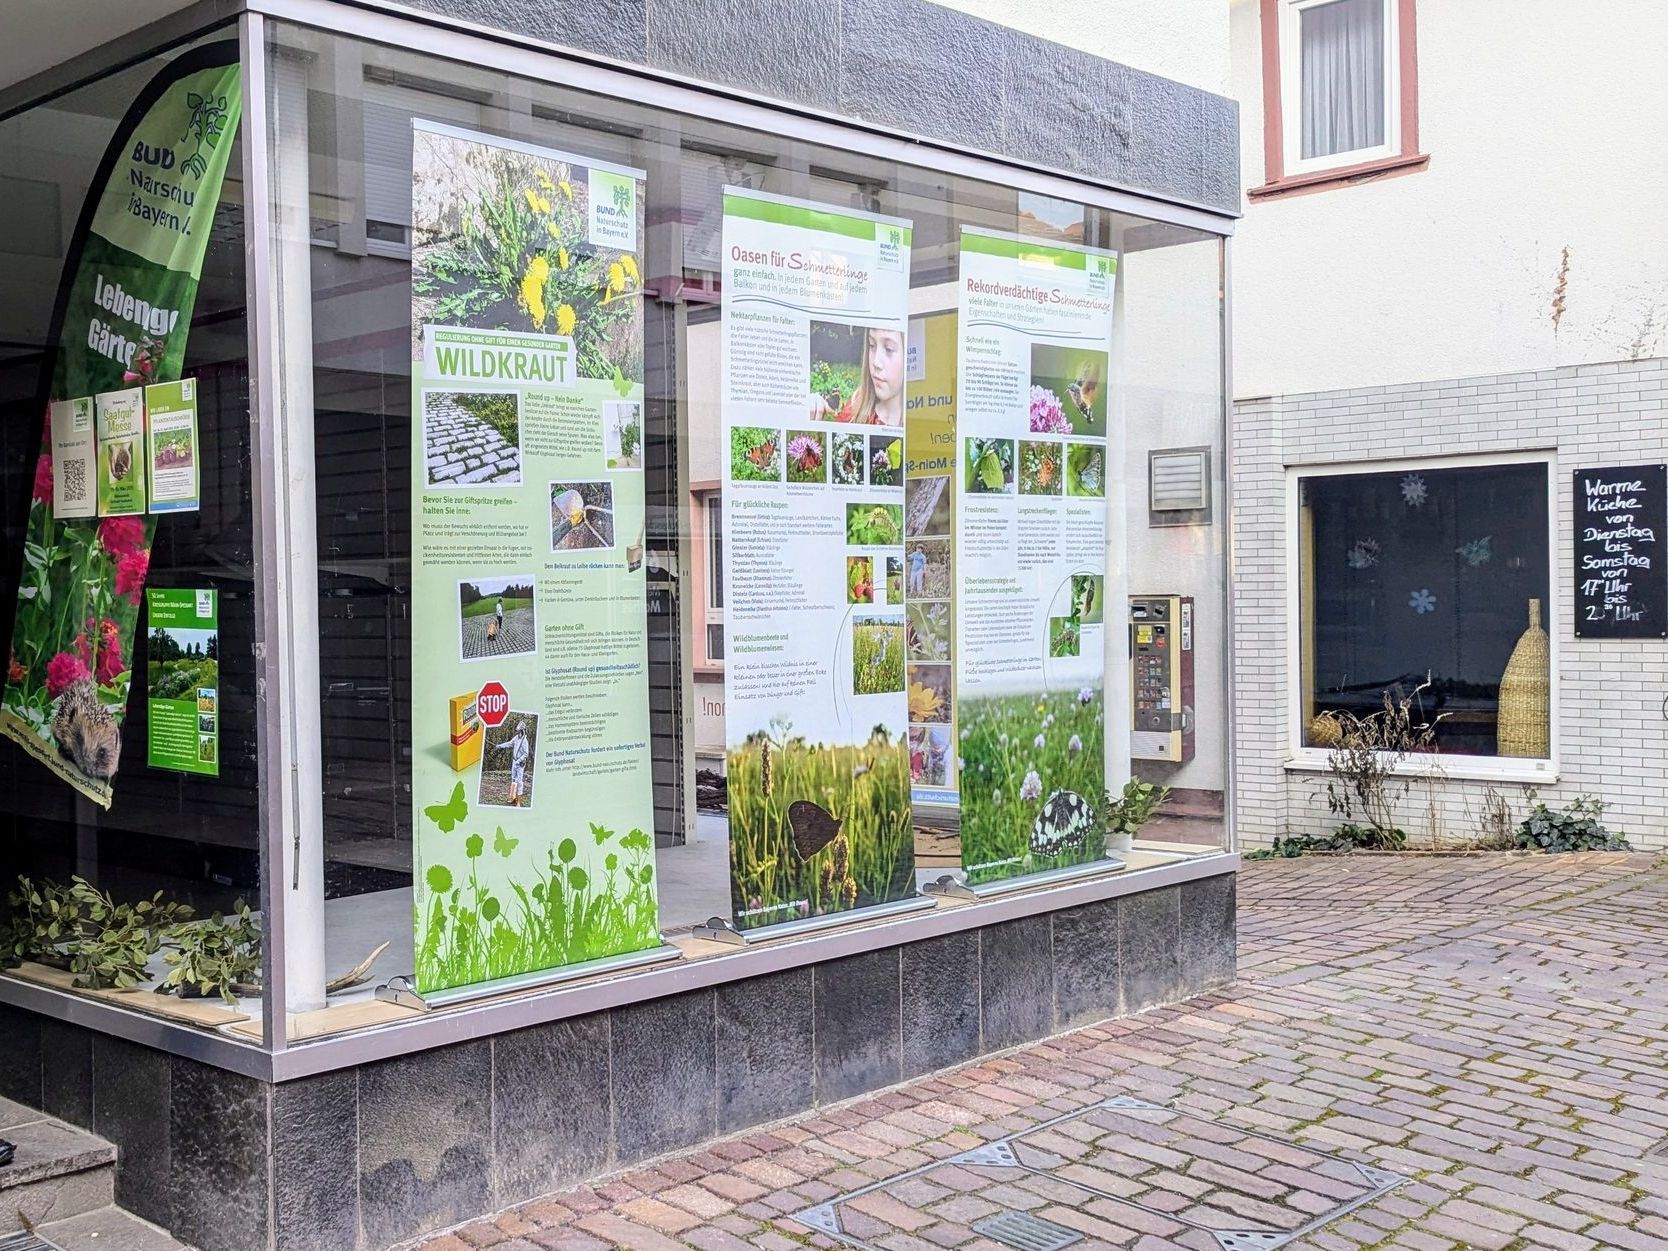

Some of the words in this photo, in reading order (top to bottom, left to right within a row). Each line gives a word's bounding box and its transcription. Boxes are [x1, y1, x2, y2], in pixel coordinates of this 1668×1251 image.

[597, 205, 615, 215] BUND
[596, 216, 628, 229] Naturschutz
[602, 227, 620, 237] Bayern
[732, 246, 768, 265] Oasen
[770, 250, 785, 268] für
[788, 253, 868, 282] Schmetterlinge
[734, 268, 751, 279] ganz
[784, 274, 804, 286] jedem
[734, 279, 757, 290] Balkon
[759, 281, 771, 292] und
[772, 283, 778, 292] in
[778, 284, 799, 296] jedem
[968, 278, 1048, 304] Rekordverdächtige
[969, 297, 983, 306] viele
[984, 299, 998, 308] Falter
[731, 312, 771, 322] Nektarpflanzen
[436, 332, 470, 343] REGULIERUNG
[471, 336, 484, 344] OHNE
[485, 336, 496, 344] GIFT
[496, 336, 506, 345] FÜR
[435, 347, 567, 382] WILDKRAUT
[104, 406, 135, 422] Saatgut-
[108, 421, 132, 431] Messe
[1585, 479, 1647, 496] Warme
[464, 497, 492, 506] Giftspritze
[494, 497, 512, 506] greifen
[743, 501, 770, 509] glückliche
[1587, 495, 1642, 512] Küche
[1605, 514, 1634, 524] von
[1583, 523, 1655, 542] Dienstag
[1604, 540, 1632, 552] bis
[1581, 551, 1651, 569] Samstag
[1601, 569, 1627, 578] von
[1604, 579, 1632, 593] Uhr
[1604, 594, 1627, 603] bis
[1616, 606, 1644, 621] Uhr
[480, 695, 506, 713] STOP
[554, 758, 575, 766] Glyphosat
